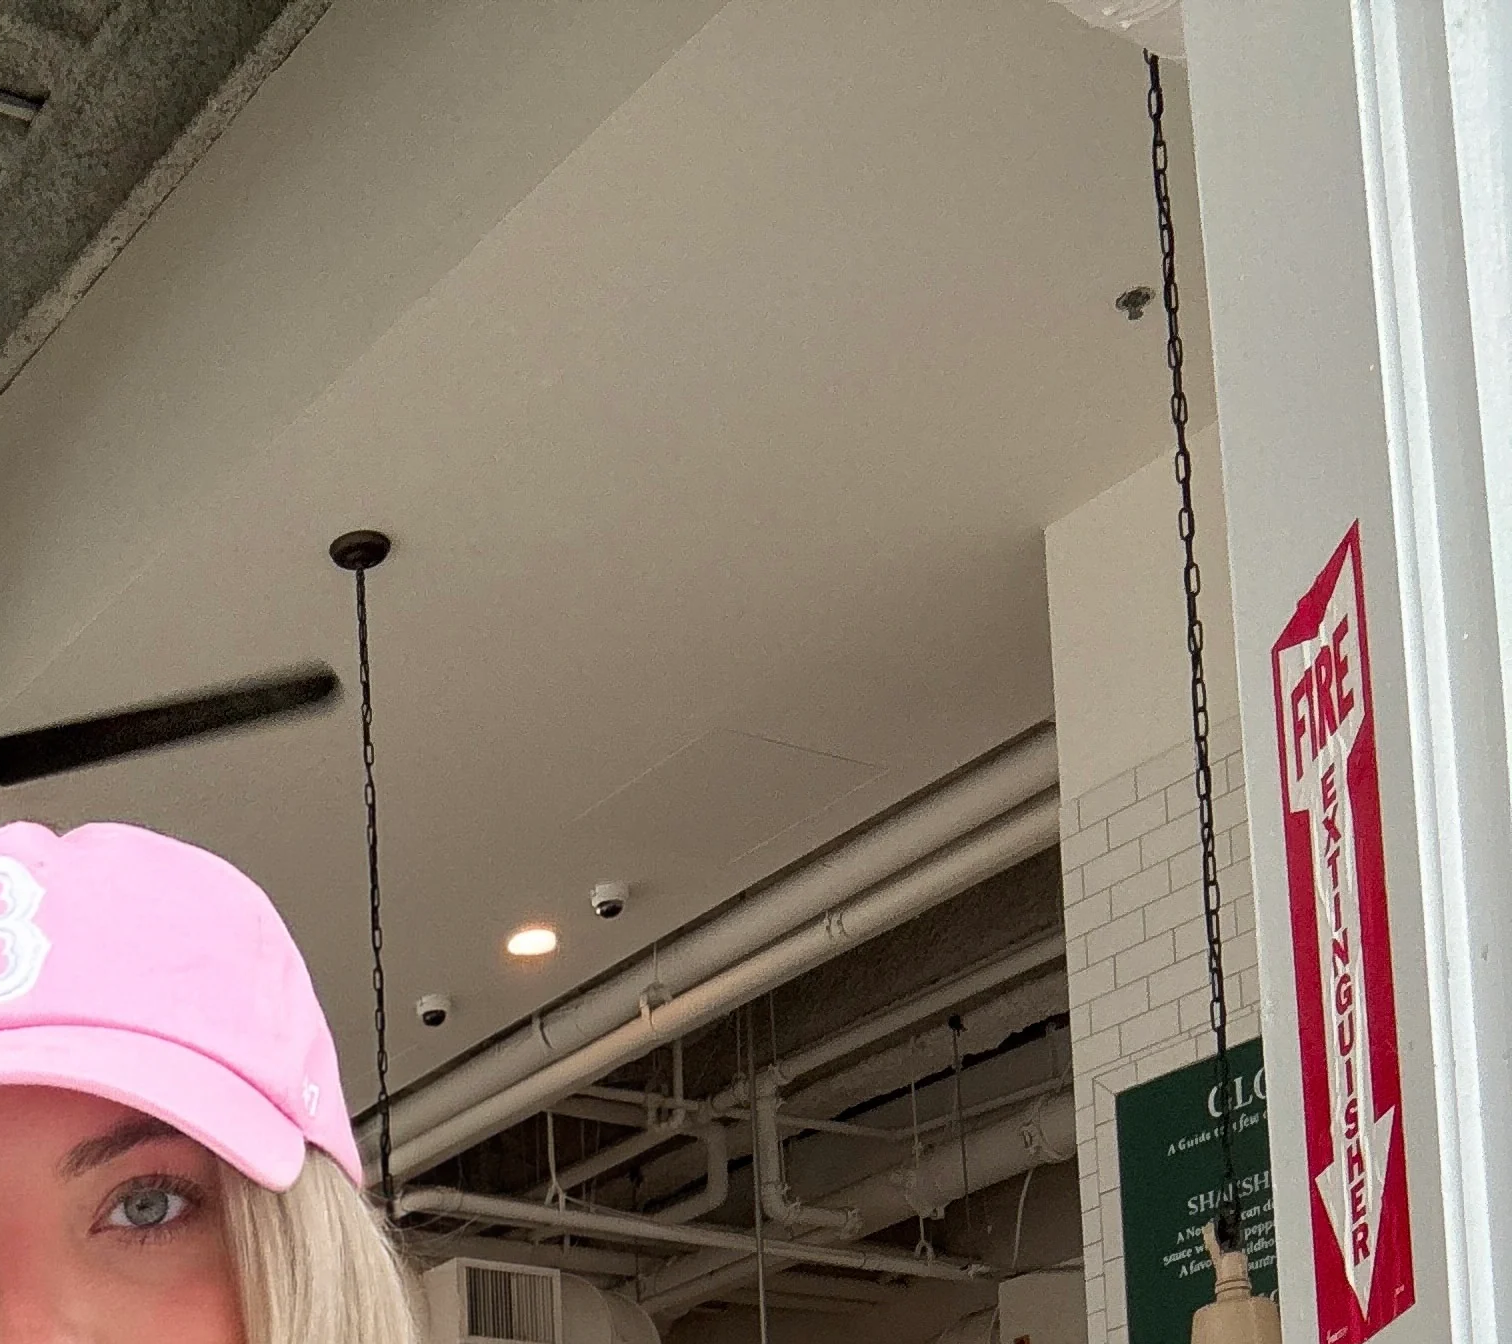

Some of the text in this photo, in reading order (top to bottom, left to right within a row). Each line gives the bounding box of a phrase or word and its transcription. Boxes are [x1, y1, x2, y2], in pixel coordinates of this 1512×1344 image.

[1290, 613, 1355, 783] FIRE
[1320, 762, 1372, 1267] EXTINGUISHER
[1178, 1130, 1211, 1151] Guide
